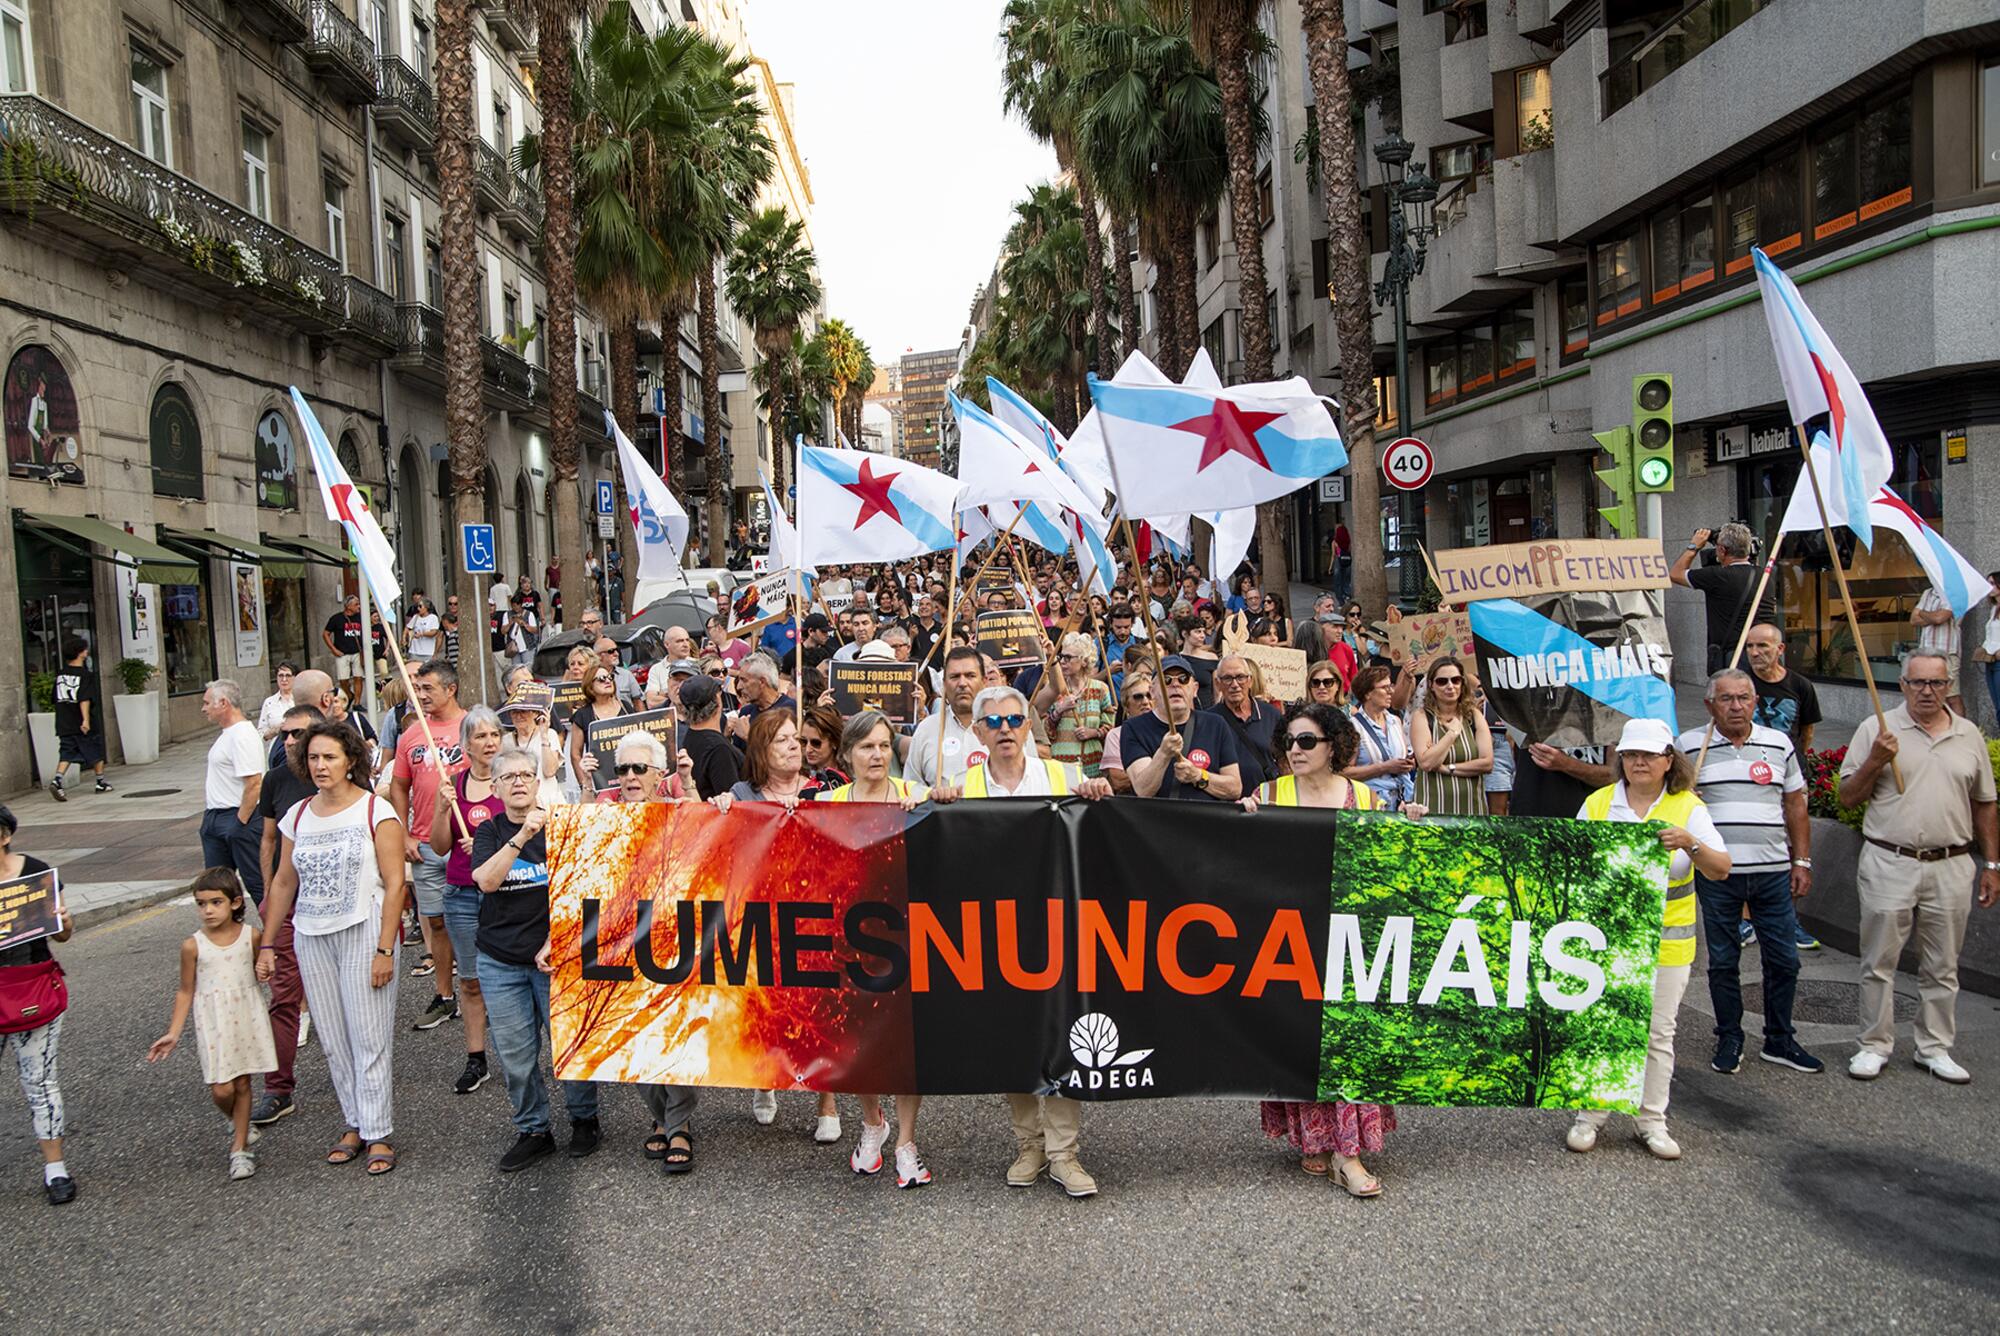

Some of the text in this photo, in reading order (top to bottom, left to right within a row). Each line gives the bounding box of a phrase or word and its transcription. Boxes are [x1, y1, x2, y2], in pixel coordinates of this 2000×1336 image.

[1751, 427, 1792, 454] habitat
[1394, 455, 1423, 472] 40
[601, 486, 610, 511] P
[1440, 545, 1668, 594] INCOMPPETENTES
[760, 578, 787, 597] NUNCA
[766, 590, 786, 605] MÁIS
[1007, 628, 1019, 638] DO
[1486, 636, 1670, 690] NUNCA MÁIS
[837, 669, 913, 682] LUMES FORESTAIS
[847, 682, 902, 695] NUNCA MÁIS
[592, 731, 598, 741] O
[599, 723, 638, 740] EUCALIPTO
[644, 718, 672, 730] PRAGA
[506, 866, 536, 881] UNCA
[1069, 1068, 1155, 1090] ADEGA
